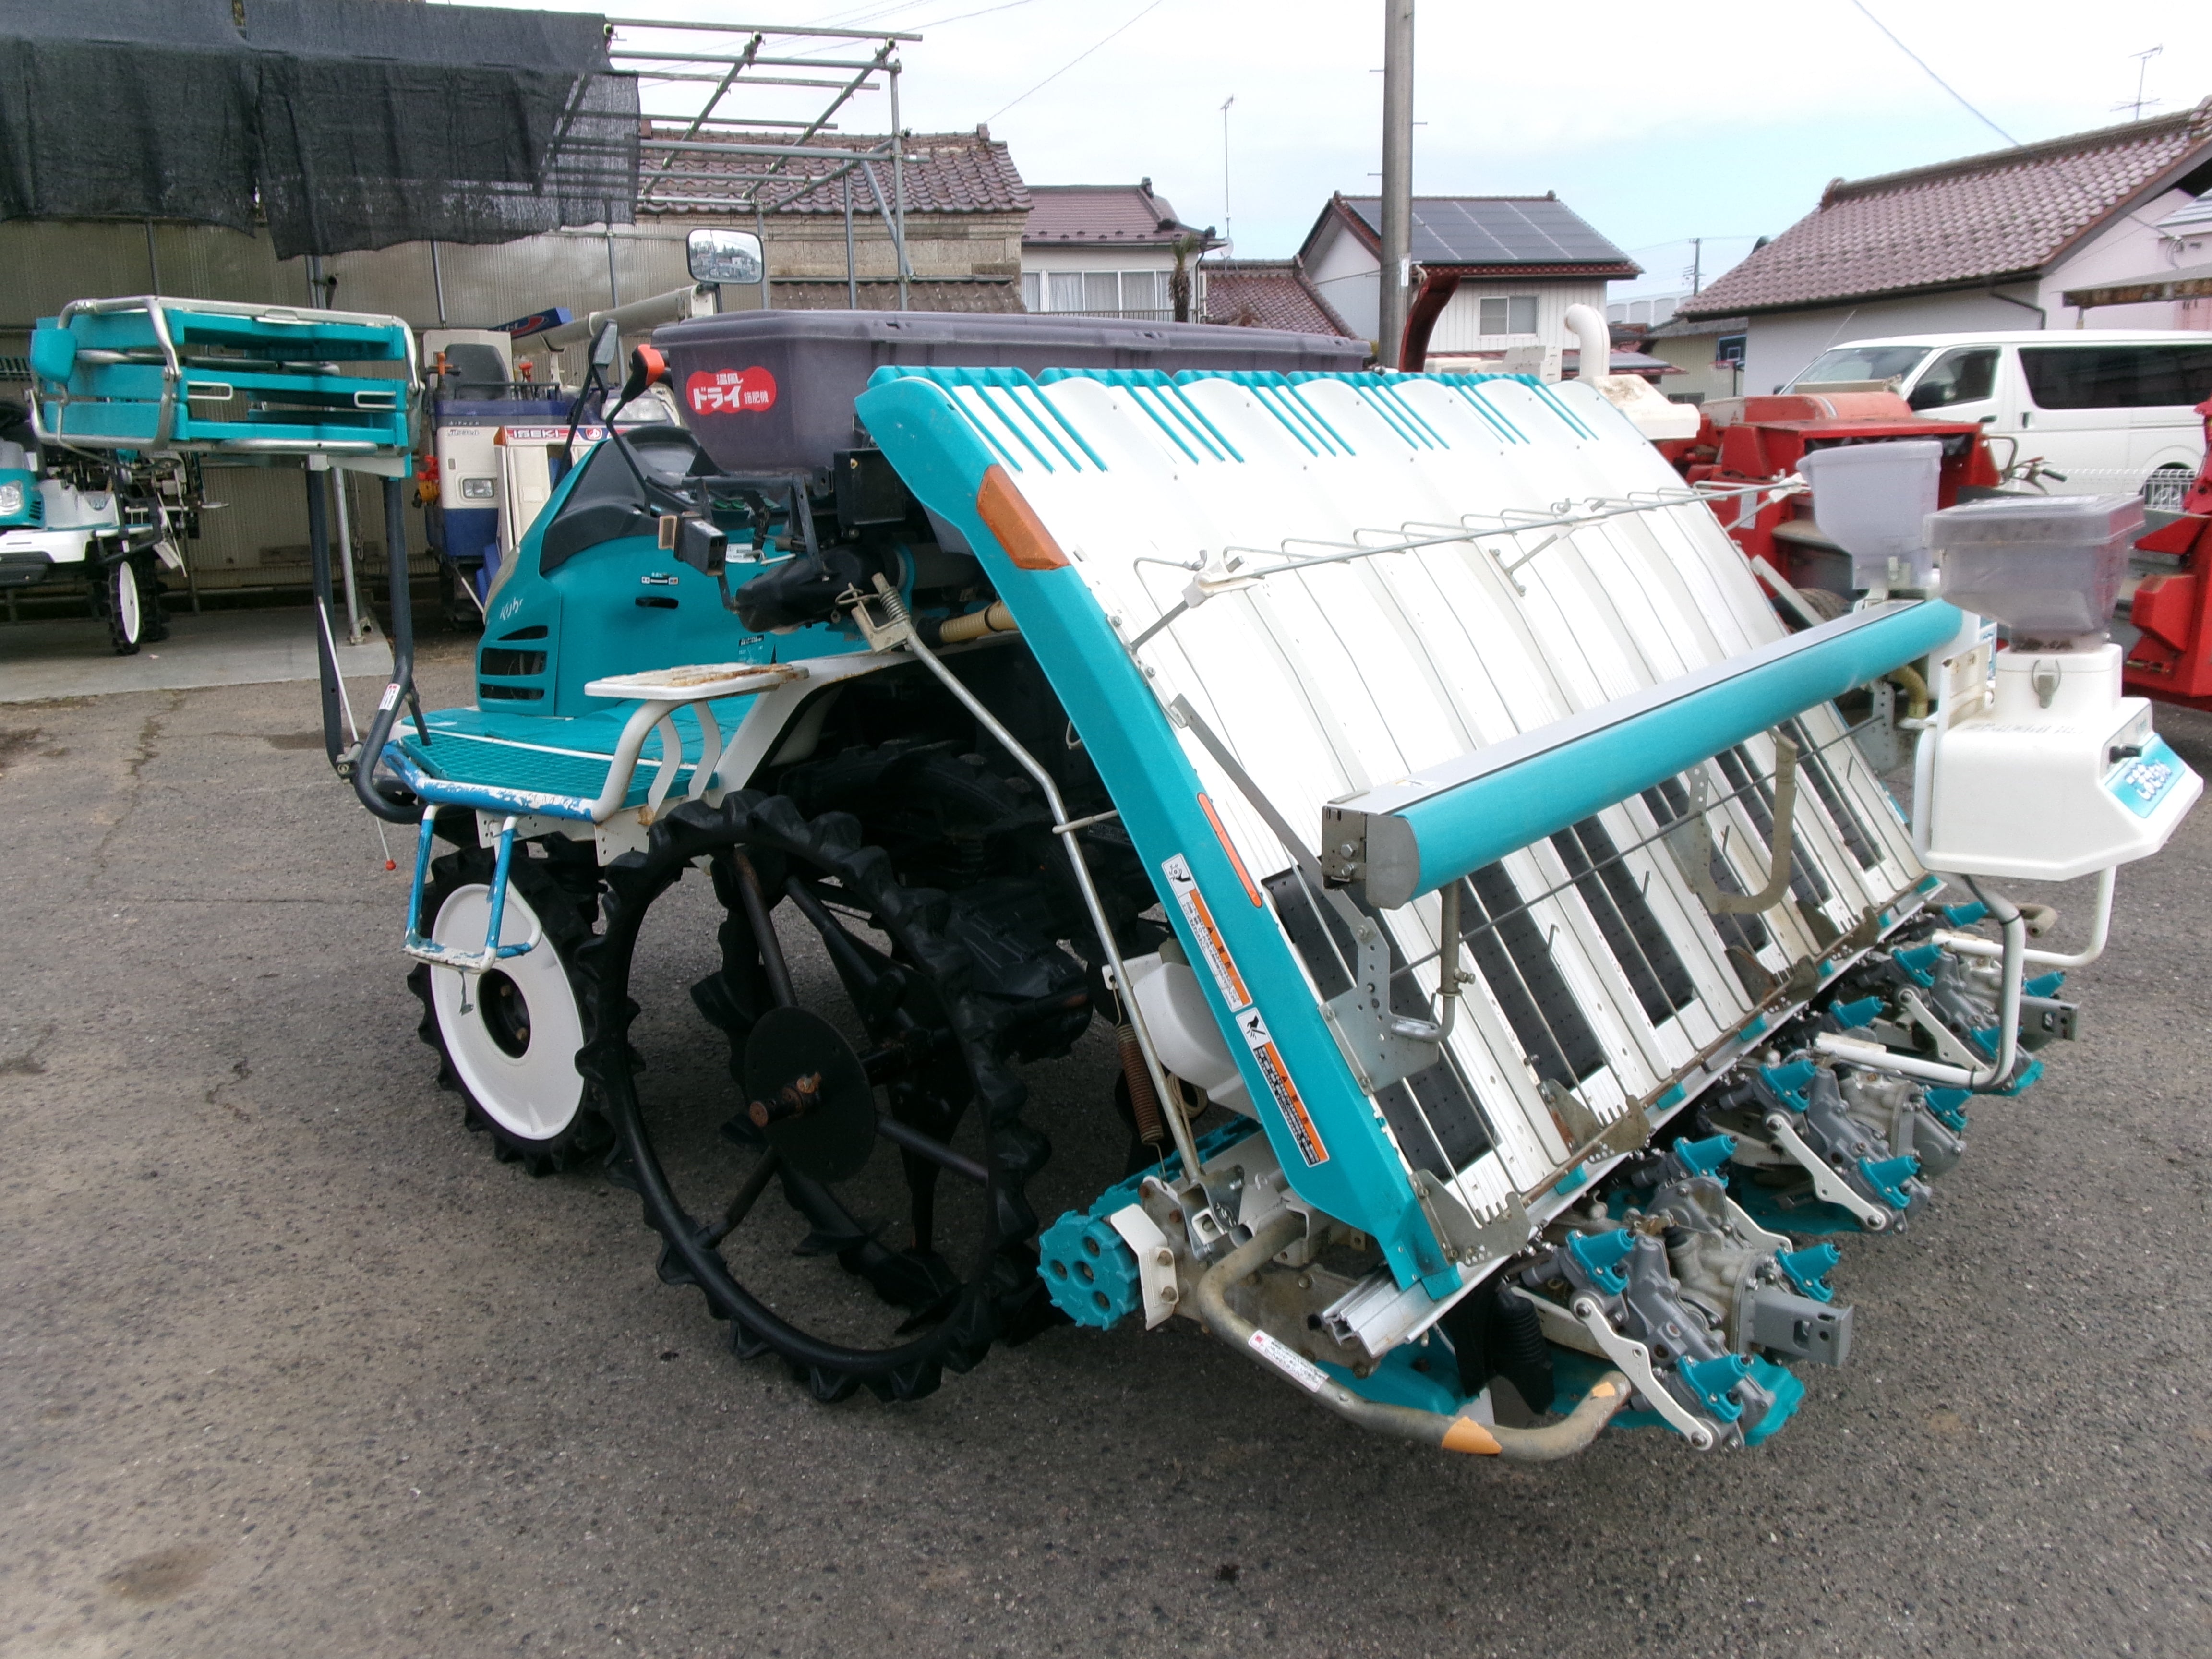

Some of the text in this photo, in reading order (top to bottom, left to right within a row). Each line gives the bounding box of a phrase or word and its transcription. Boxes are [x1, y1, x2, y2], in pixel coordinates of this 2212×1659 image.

[693, 385, 741, 410] ドライ
[513, 429, 559, 438] ISEKI
